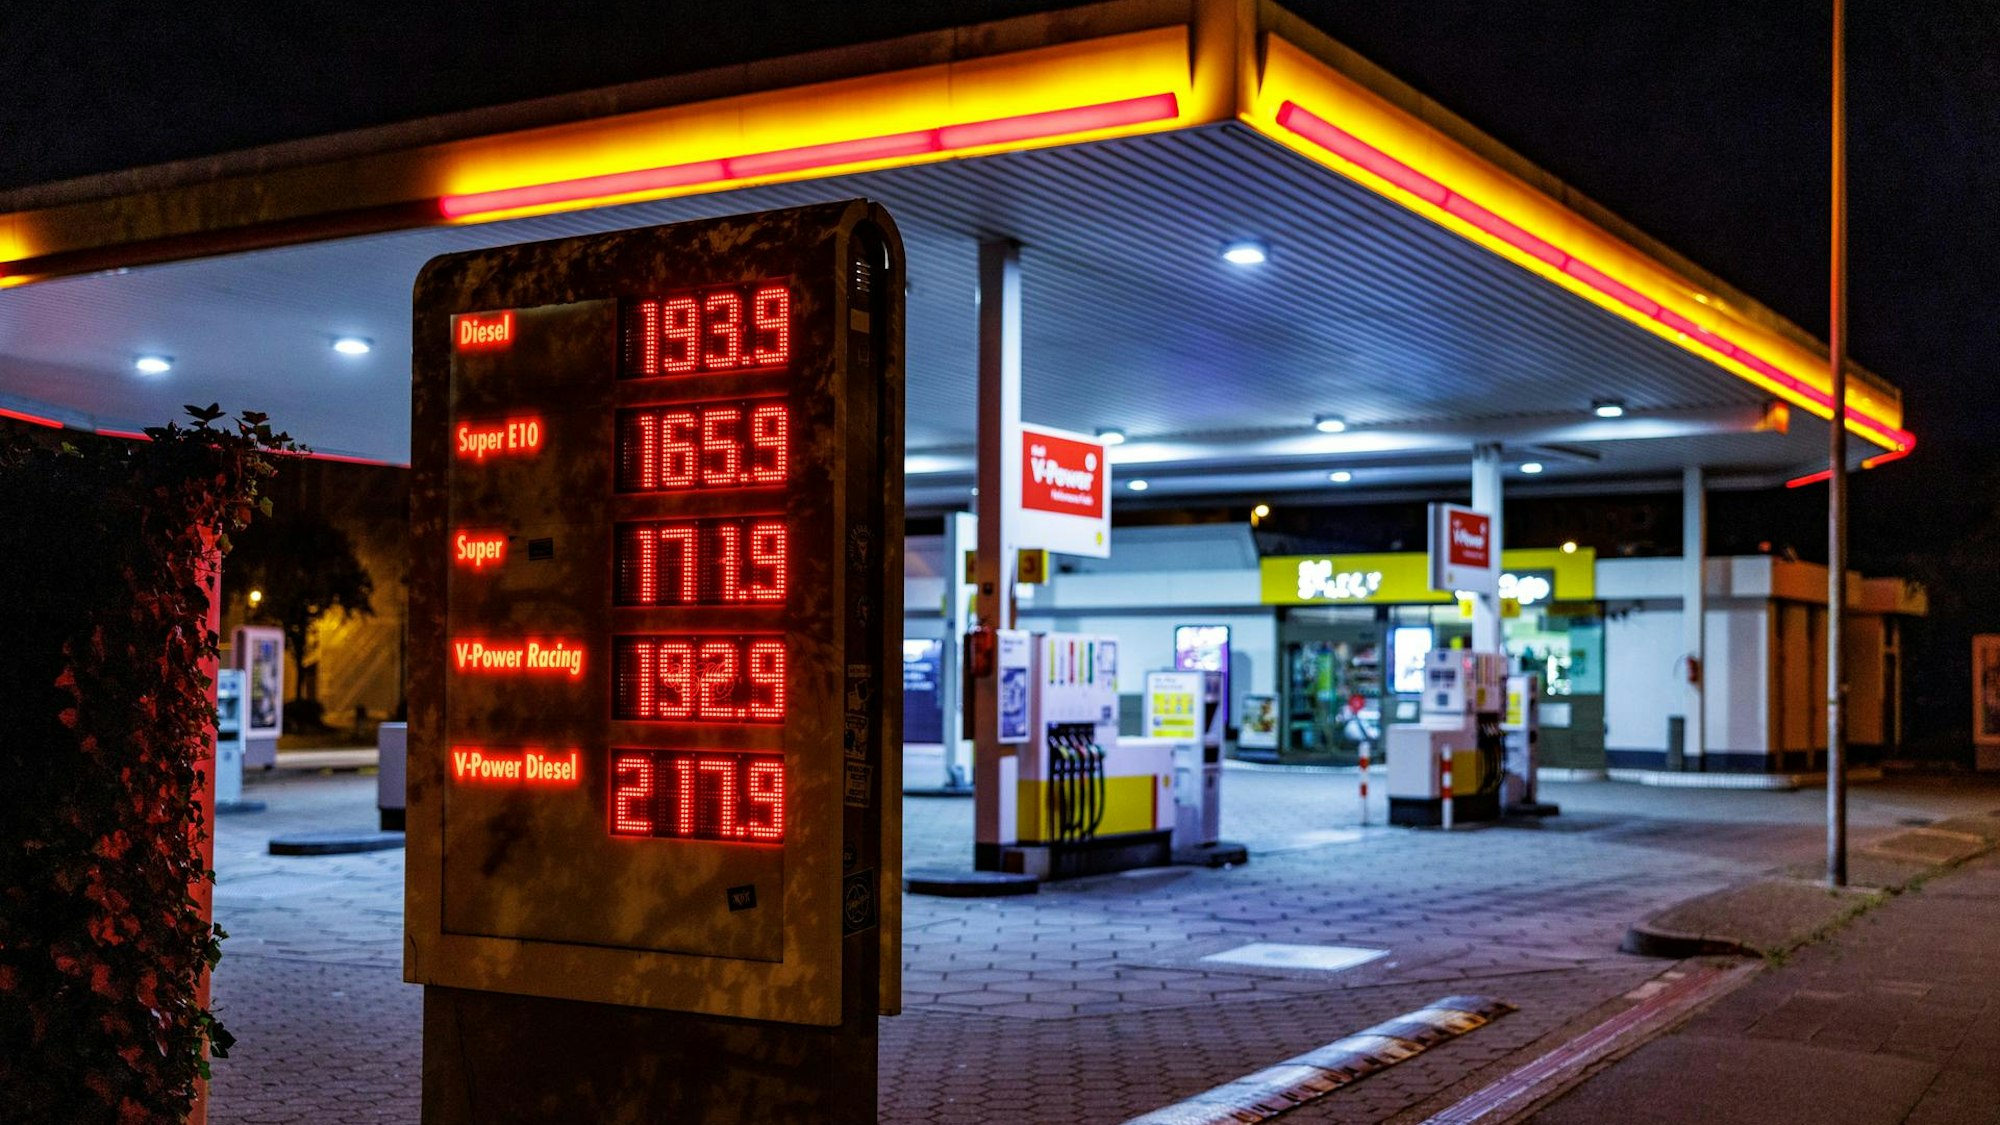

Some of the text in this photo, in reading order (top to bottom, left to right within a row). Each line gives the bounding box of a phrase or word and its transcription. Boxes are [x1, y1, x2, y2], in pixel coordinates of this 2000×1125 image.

[460, 314, 510, 346] Diesel
[643, 288, 788, 374] 193.9
[458, 421, 539, 458] Super E10
[641, 406, 787, 488] 165.9
[457, 535, 503, 567] Super
[639, 525, 785, 602] 171.9
[455, 642, 582, 675] V-Power Racing
[638, 643, 784, 718] 192.9
[453, 752, 577, 780] V-Power Diesel
[617, 758, 783, 837] 217.9
